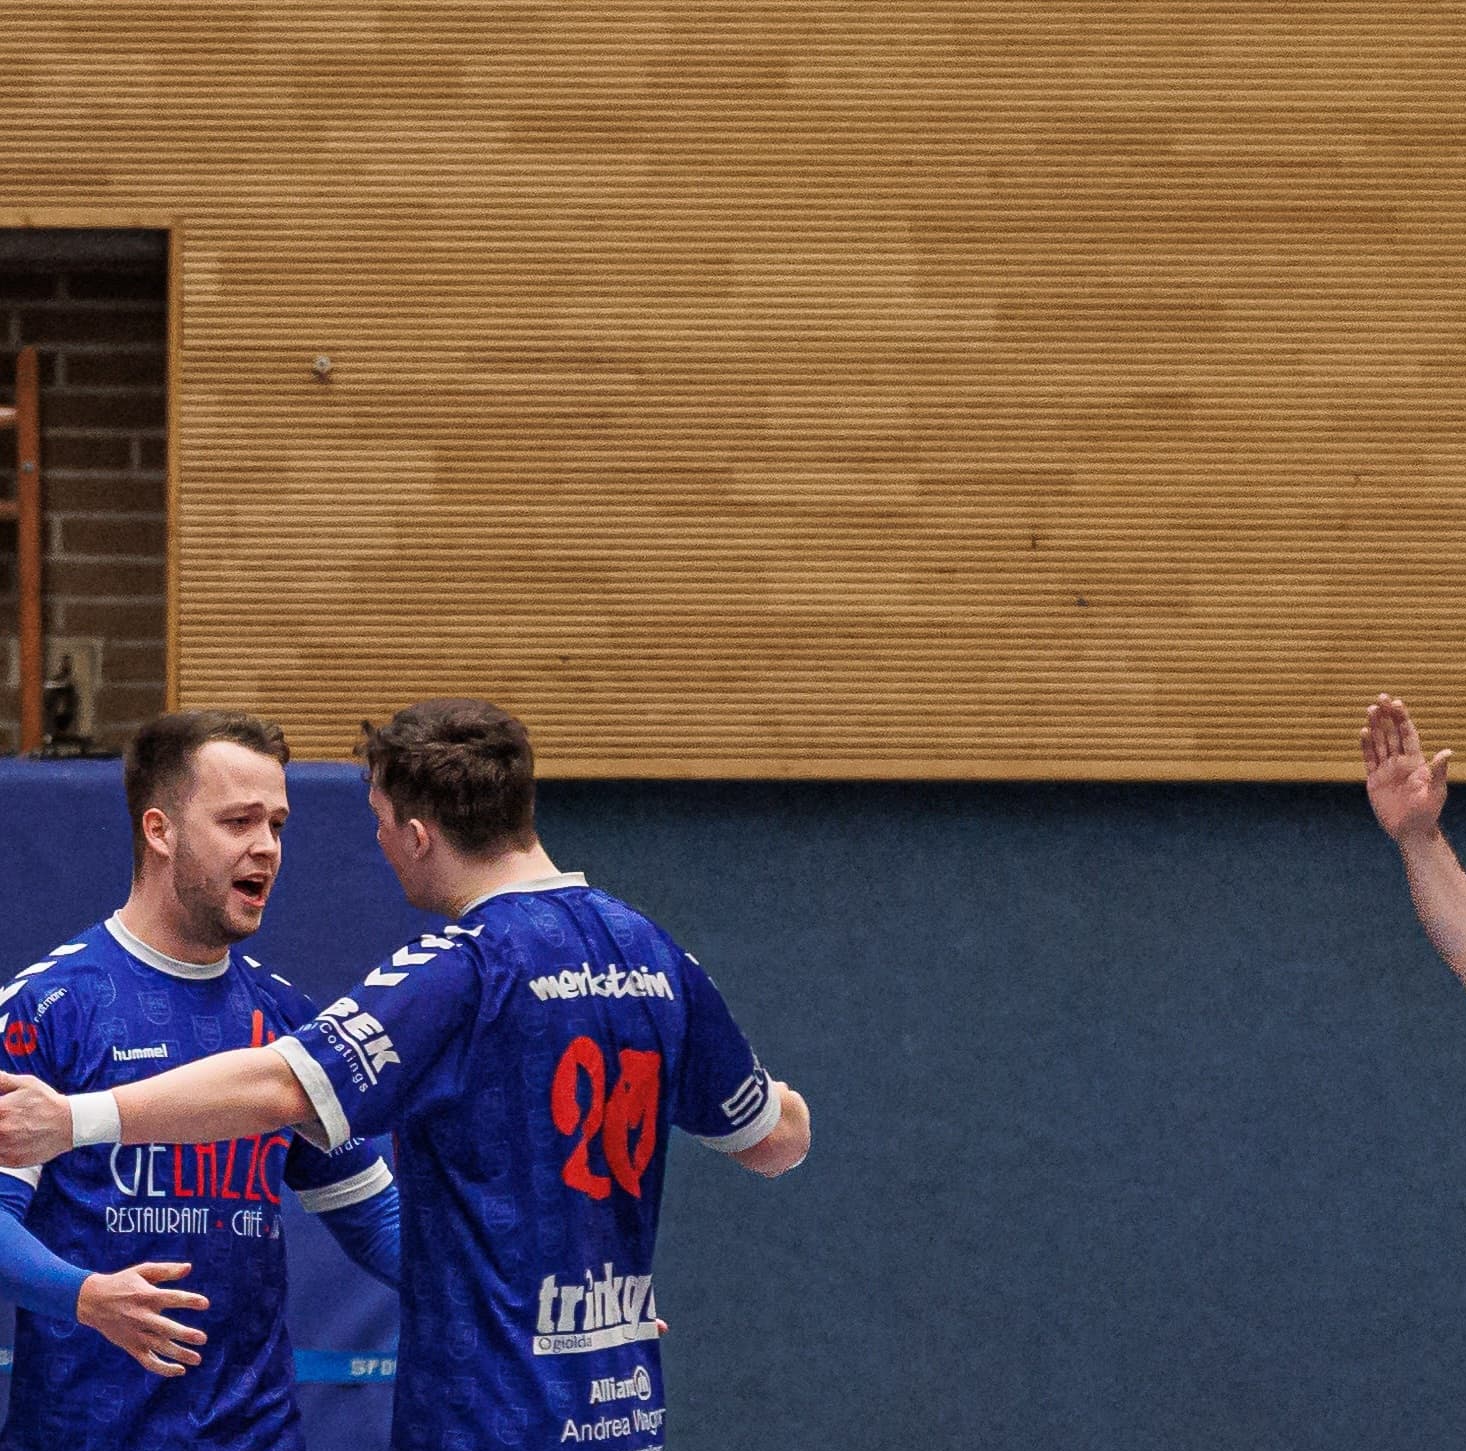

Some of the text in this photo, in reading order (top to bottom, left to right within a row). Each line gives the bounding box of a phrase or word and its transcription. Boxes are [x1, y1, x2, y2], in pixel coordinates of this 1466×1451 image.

[112, 1043, 169, 1062] hummel
[319, 1022, 369, 1093] Coatings
[551, 1035, 662, 1200] 20
[106, 1206, 209, 1234] RESTAURANT
[231, 1207, 263, 1238] CAFÉ
[561, 1416, 632, 1443] Andrea
